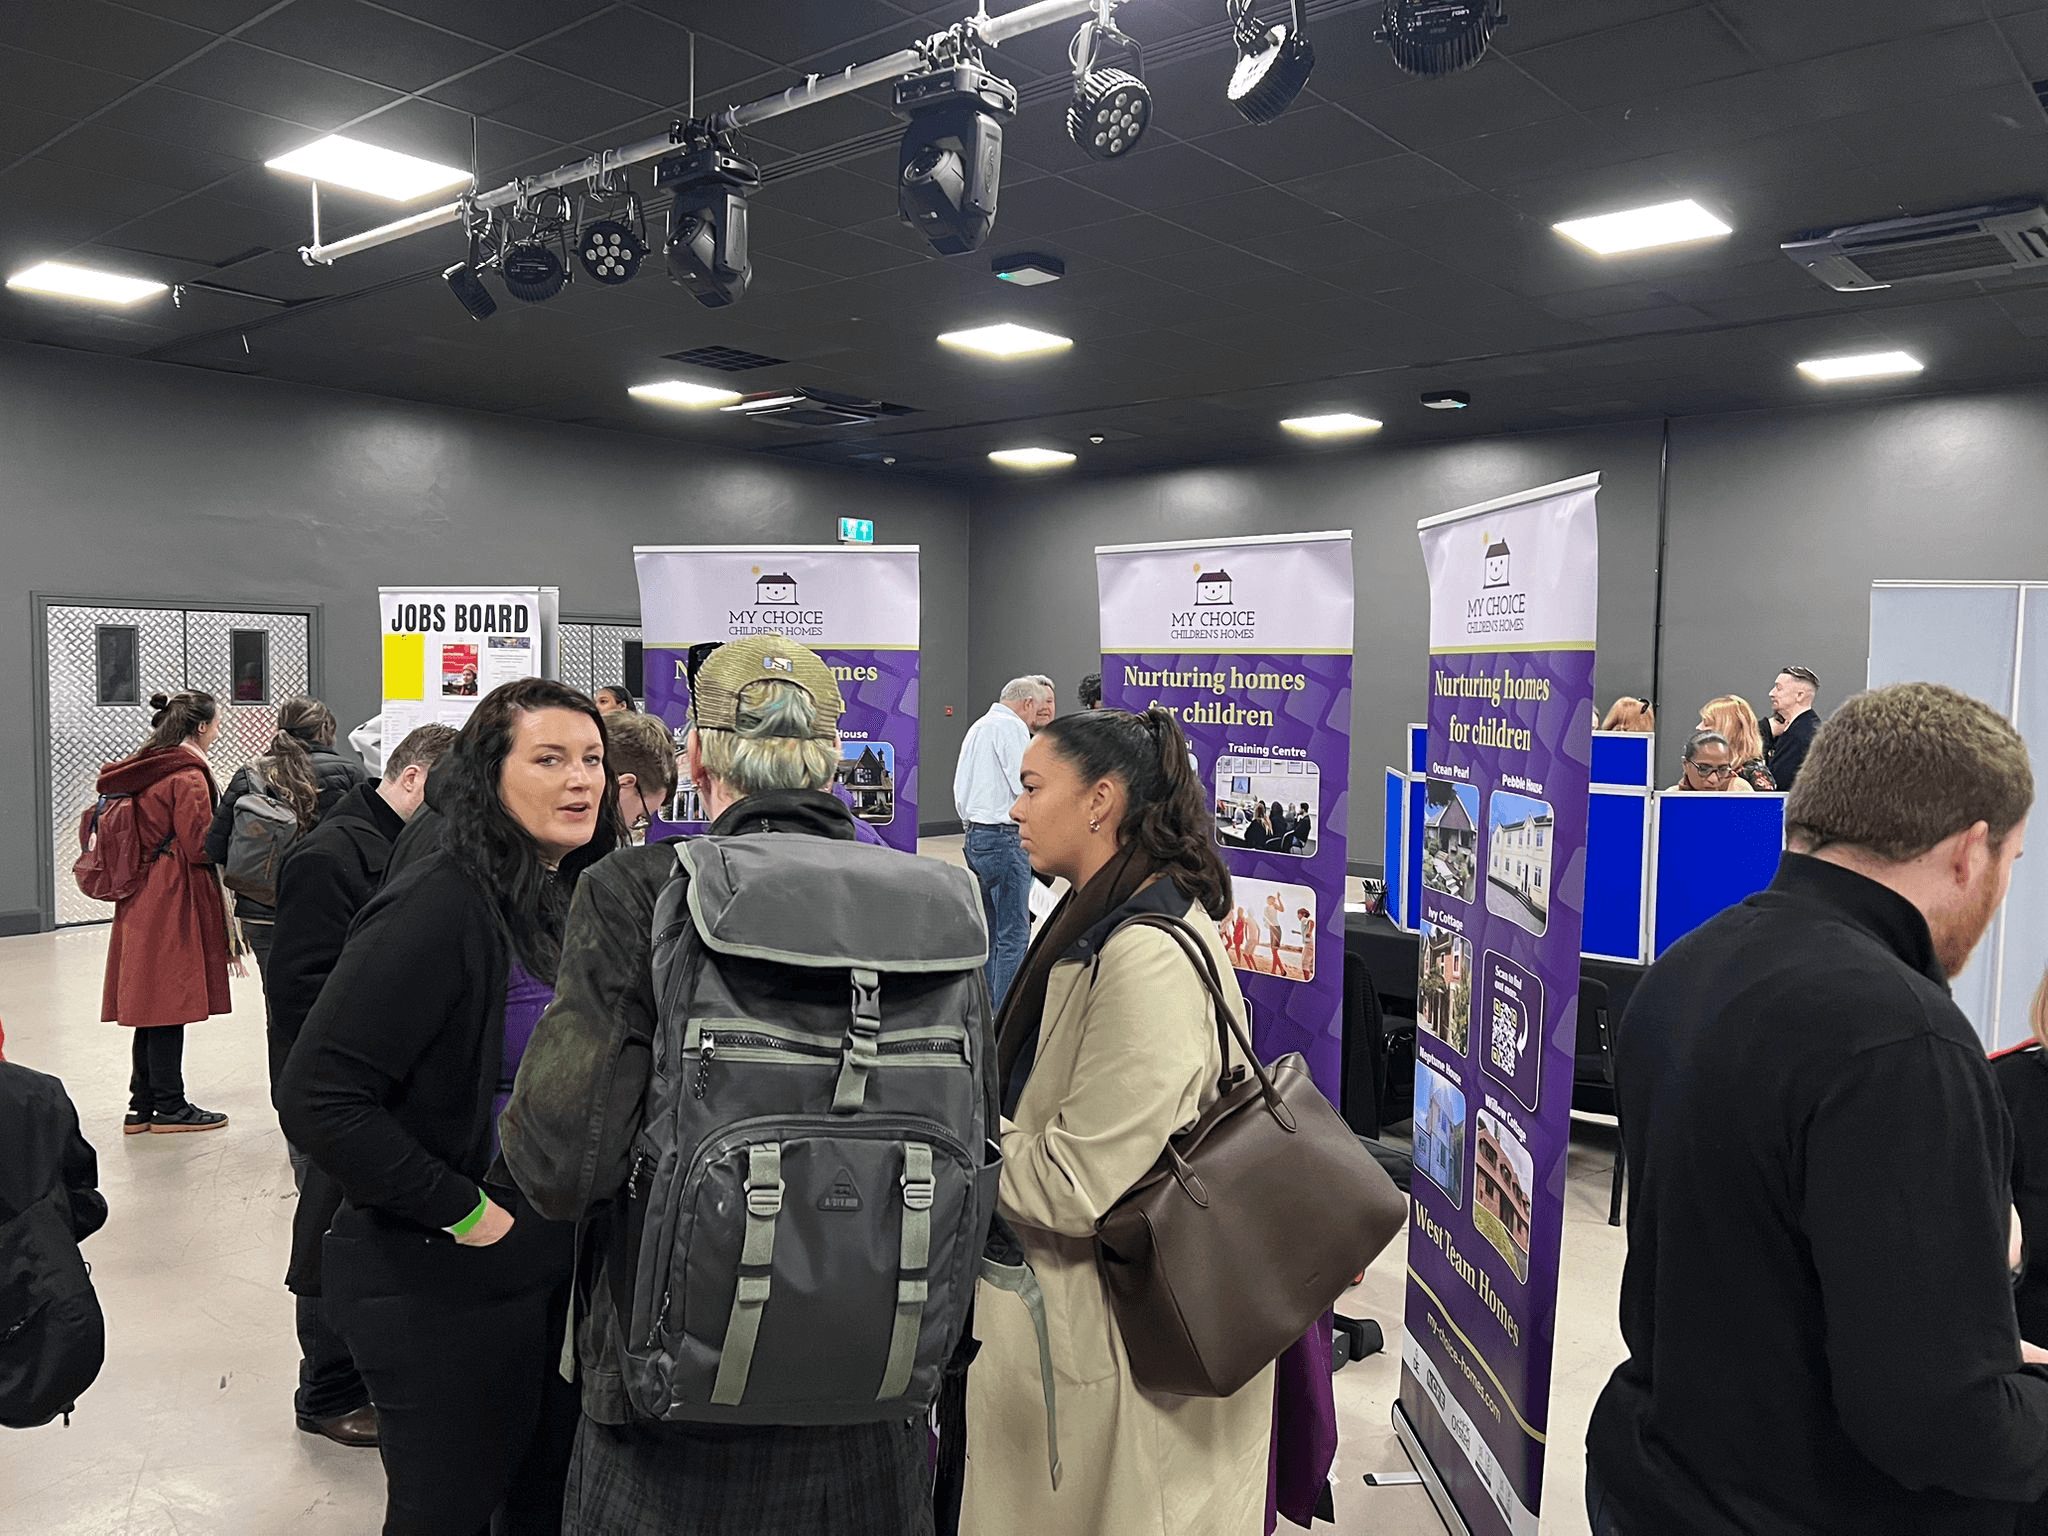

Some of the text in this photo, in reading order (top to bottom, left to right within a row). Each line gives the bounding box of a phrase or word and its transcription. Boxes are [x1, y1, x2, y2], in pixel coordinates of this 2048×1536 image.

[1467, 593, 1525, 618] MY CHOICE
[391, 603, 529, 633] JOBS BOARD
[729, 610, 824, 624] MY CHOICE
[1171, 611, 1255, 627] MY CHOICE
[1499, 618, 1524, 632] HOMES
[786, 627, 823, 636] HOMES
[1220, 629, 1254, 639] HOMES
[829, 665, 878, 681] mes
[1123, 665, 1306, 695] Nurturing homes
[1434, 669, 1550, 708] Nurturing homes
[1182, 701, 1274, 727] children
[1448, 714, 1531, 751] for children
[1228, 742, 1307, 758] Training Centre
[1432, 762, 1470, 779] Ocean Pearl
[1502, 774, 1543, 795] Pebble House
[1438, 911, 1464, 932] Cottage
[1414, 1198, 1519, 1347] West Team Homes
[1427, 1311, 1501, 1424] my-choice-homes.com
